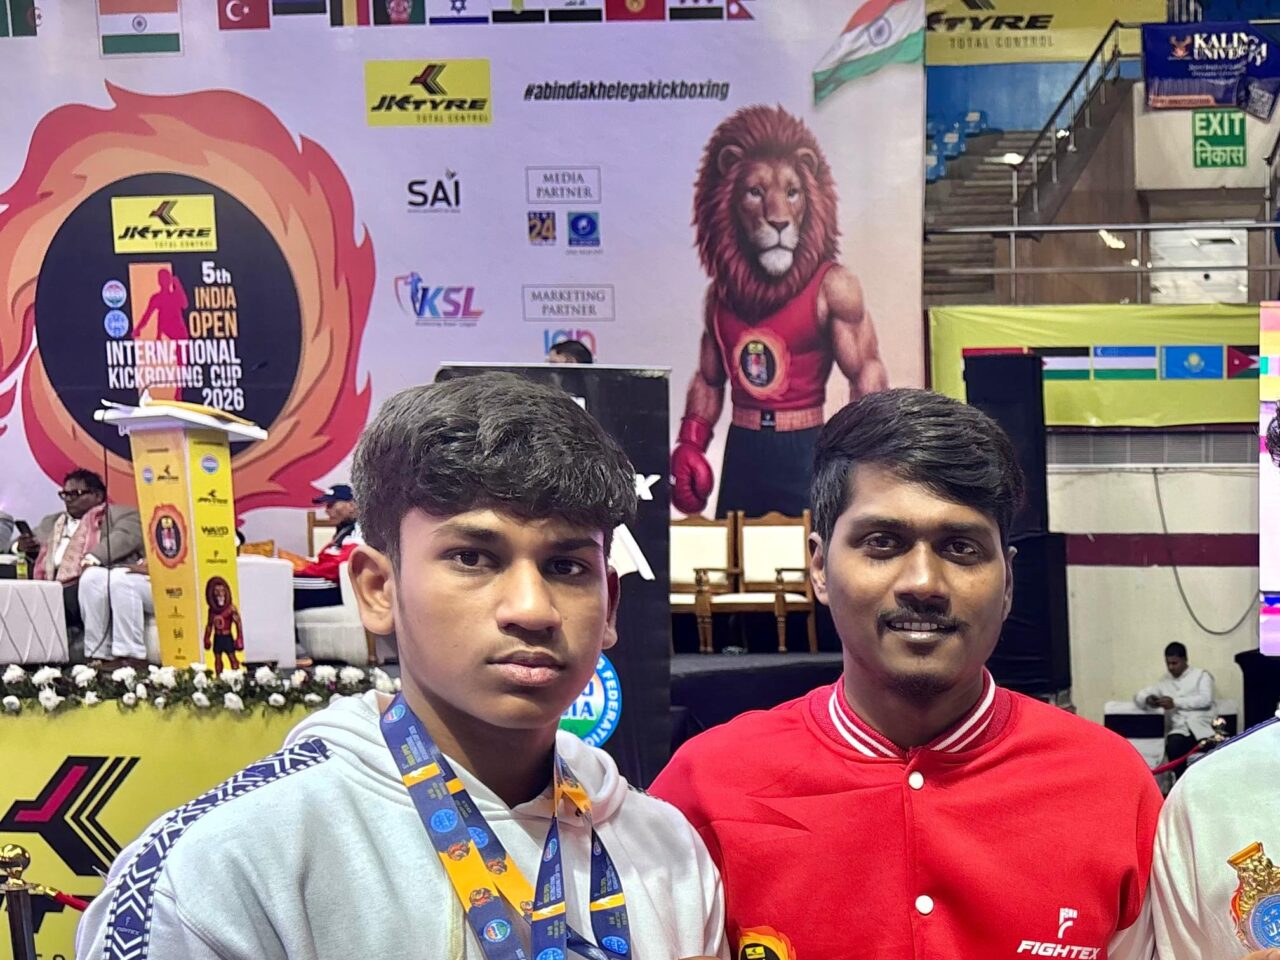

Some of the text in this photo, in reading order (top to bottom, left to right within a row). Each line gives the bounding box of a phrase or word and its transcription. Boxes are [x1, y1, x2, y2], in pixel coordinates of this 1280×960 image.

[524, 79, 730, 102] #abindiakhelegakickboxing
[1194, 113, 1244, 136] EXIT
[1194, 139, 1244, 166] निकास
[543, 172, 585, 184] MEDIA
[407, 178, 460, 207] SAI
[536, 186, 593, 199] PARTNER
[201, 261, 232, 284] 5th
[194, 286, 238, 309] INDIA
[531, 289, 606, 302] MARKETING
[541, 304, 597, 316] PARTNER
[188, 311, 239, 338] OPEN
[105, 339, 242, 366] INTERNATIONAL
[108, 364, 242, 389] KICKBOXING CUP
[202, 388, 245, 411] 2026
[583, 669, 619, 747] FEDERATIO
[1016, 940, 1101, 960] FIGHTEX
